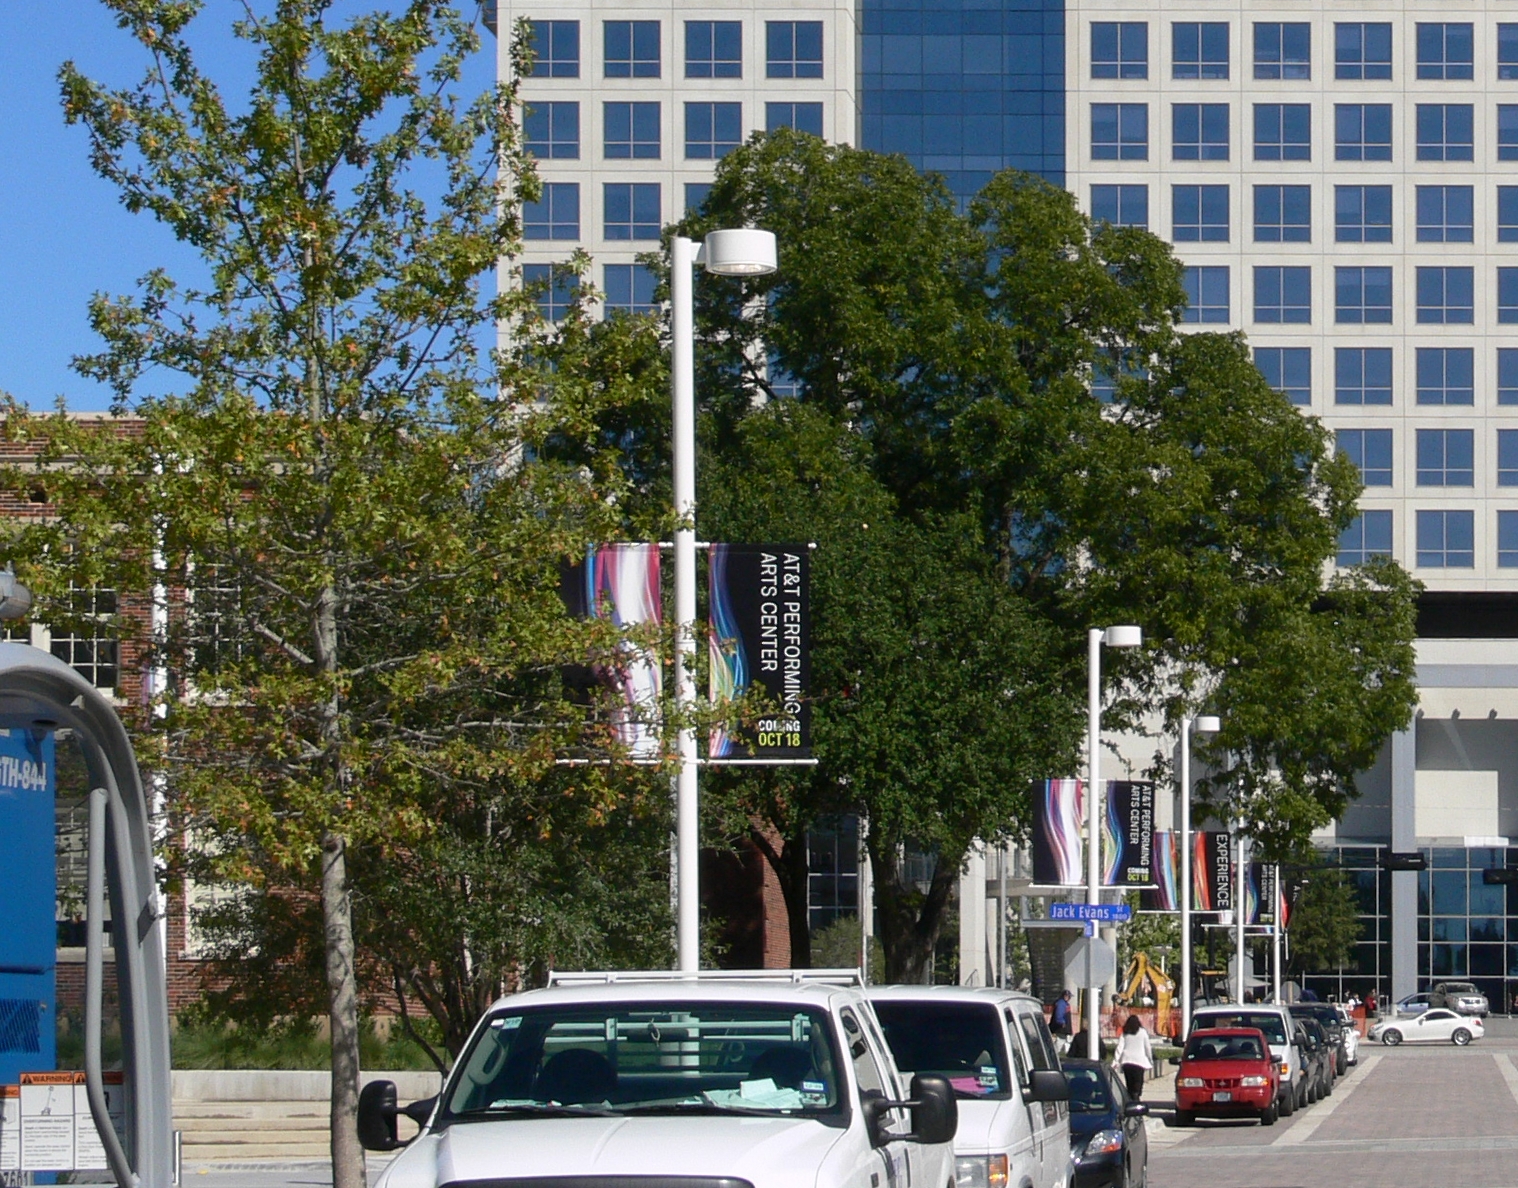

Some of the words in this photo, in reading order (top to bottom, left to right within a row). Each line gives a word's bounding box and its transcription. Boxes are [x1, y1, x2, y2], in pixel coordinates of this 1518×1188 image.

[760, 552, 778, 597] ARTS
[783, 552, 801, 597] AT&T
[760, 602, 778, 672] CENTER
[783, 601, 801, 714] PERFORMING
[758, 732, 782, 747] OCT
[786, 732, 801, 747] 18
[1130, 785, 1140, 807] ARTS
[1141, 785, 1151, 807] AT&T
[1129, 809, 1140, 845] CENTER
[1140, 809, 1151, 866] PERFORMING
[1127, 873, 1140, 882] OCT
[1216, 834, 1229, 907] EXPERIENCE
[1051, 905, 1075, 918] Jack
[1079, 906, 1109, 918] Evans
